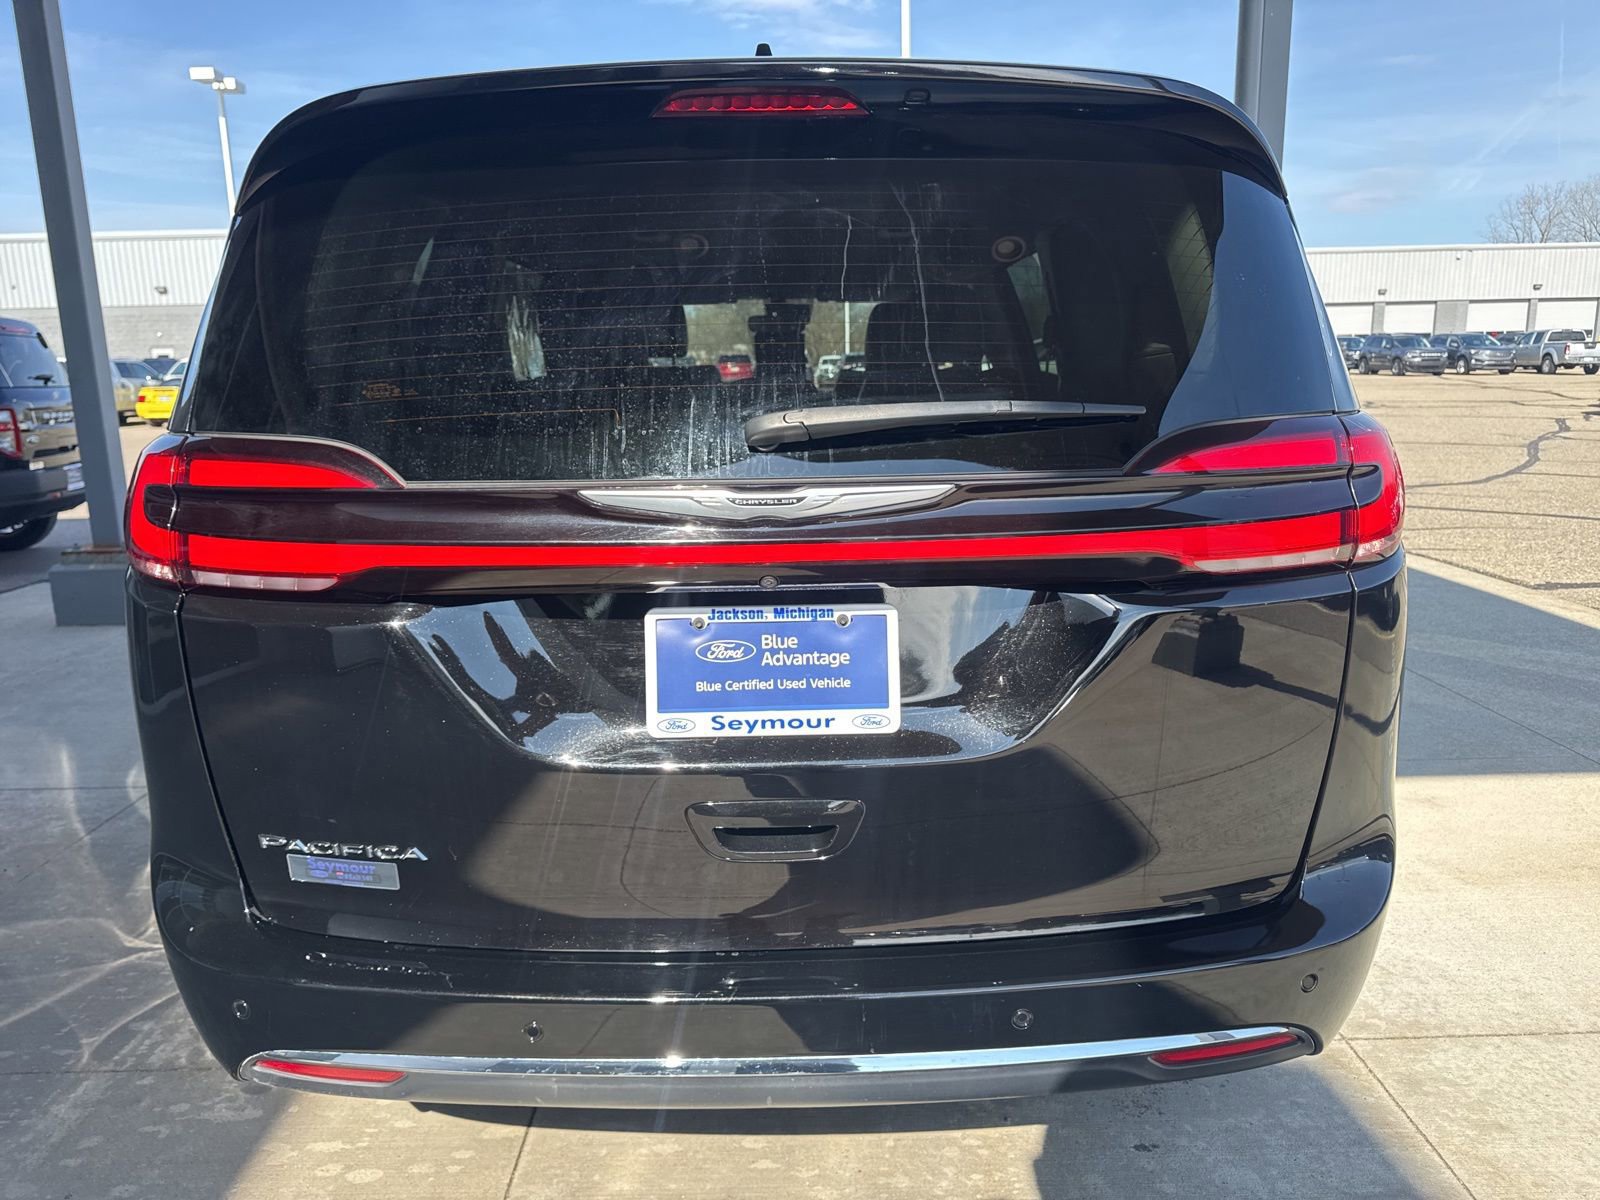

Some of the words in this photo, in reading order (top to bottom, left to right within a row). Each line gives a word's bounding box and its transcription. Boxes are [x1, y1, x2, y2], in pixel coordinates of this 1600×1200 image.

[708, 608, 769, 621] Jackson,
[773, 607, 834, 622] Michigan
[761, 634, 798, 649] Blue
[706, 642, 745, 659] Ford
[761, 650, 851, 668] Advantage
[695, 681, 722, 692] Blue
[725, 678, 774, 691] Certified
[777, 678, 806, 690] Used
[810, 677, 851, 689] Vehicle
[711, 715, 835, 734] Seymour
[257, 833, 429, 861] PACIFICA
[306, 856, 376, 874] Seymour
